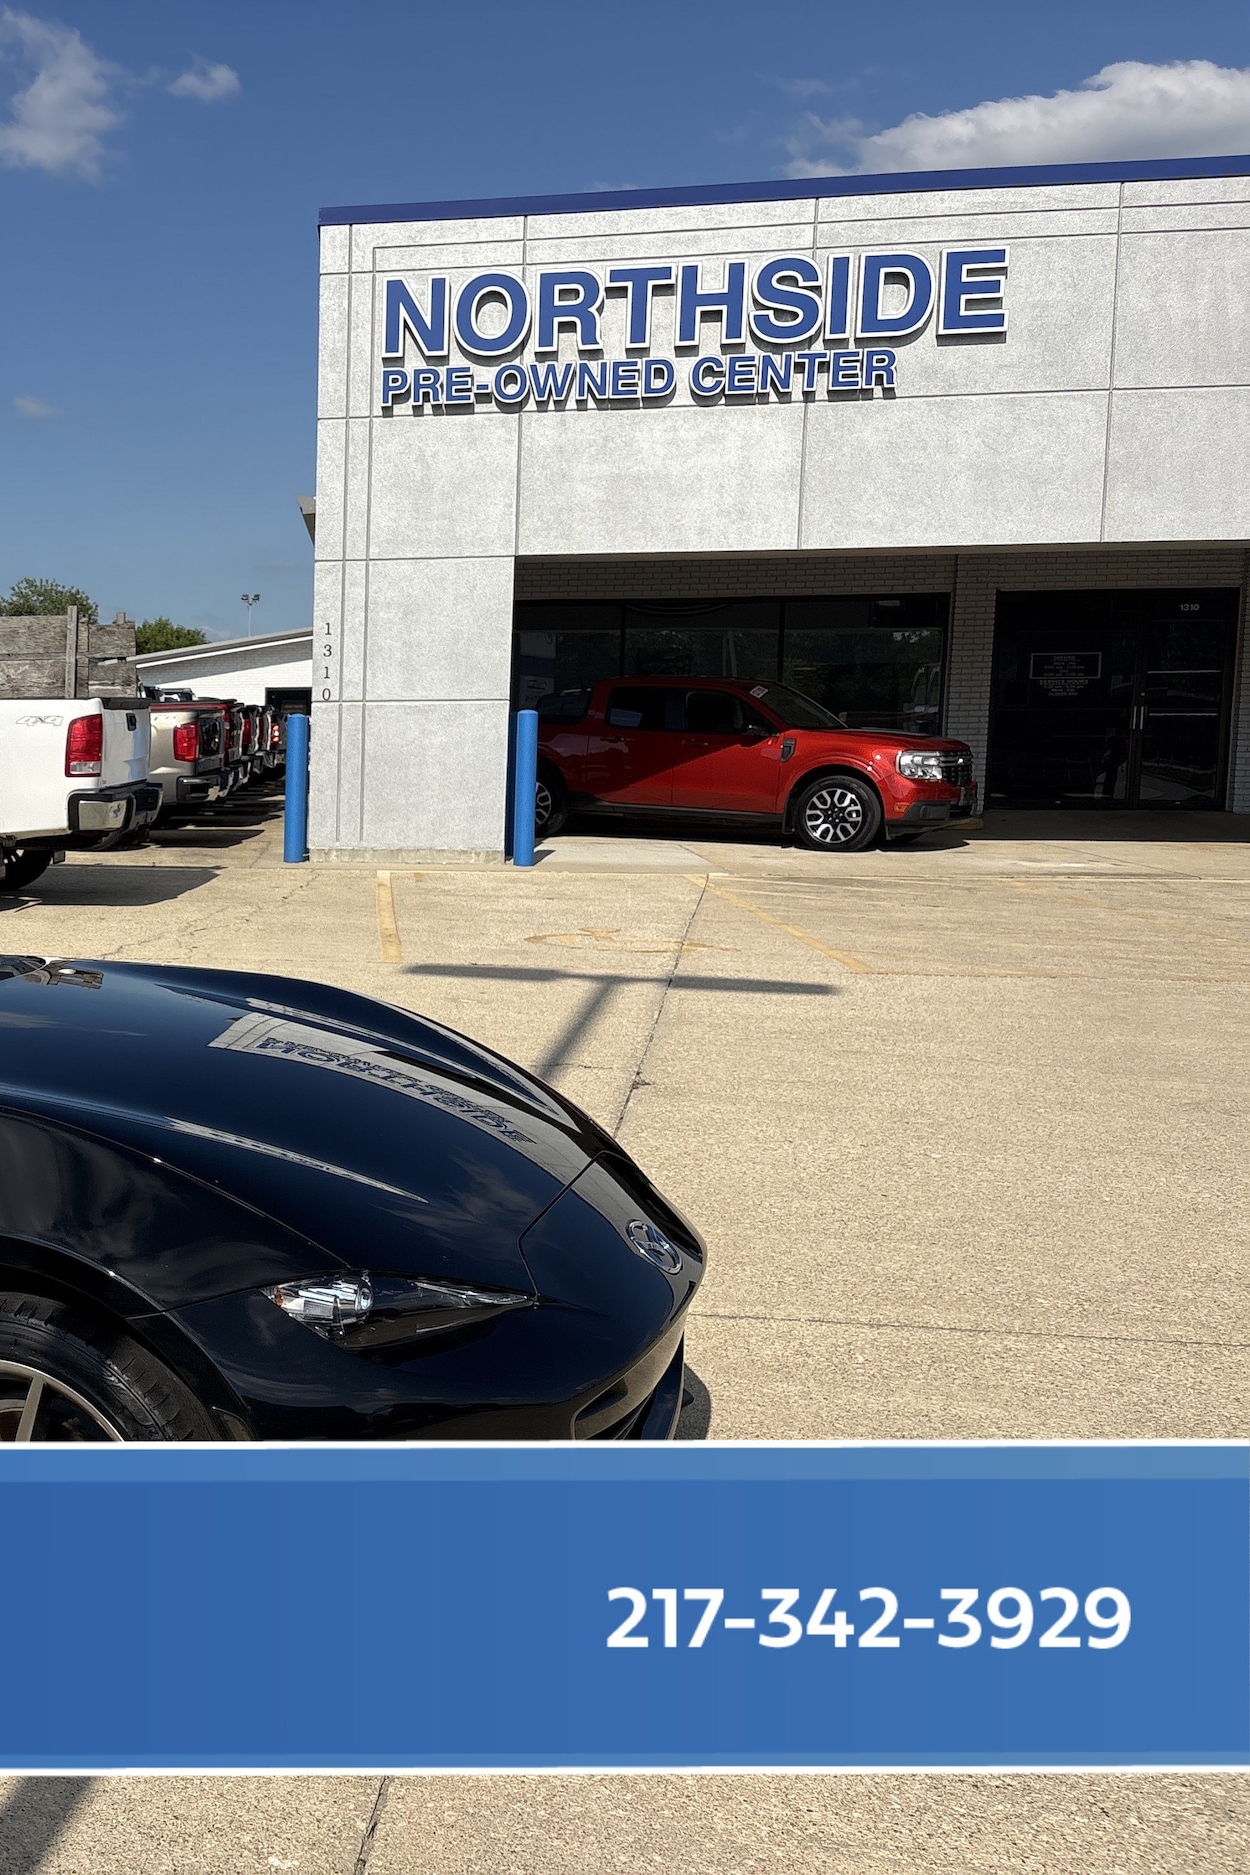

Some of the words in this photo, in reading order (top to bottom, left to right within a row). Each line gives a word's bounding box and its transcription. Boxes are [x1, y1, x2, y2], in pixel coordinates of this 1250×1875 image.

[382, 246, 1009, 358] NORTHSIDE
[381, 357, 676, 406] PRE-OWNED
[688, 348, 897, 396] CENTER
[1180, 603, 1200, 611] 1310
